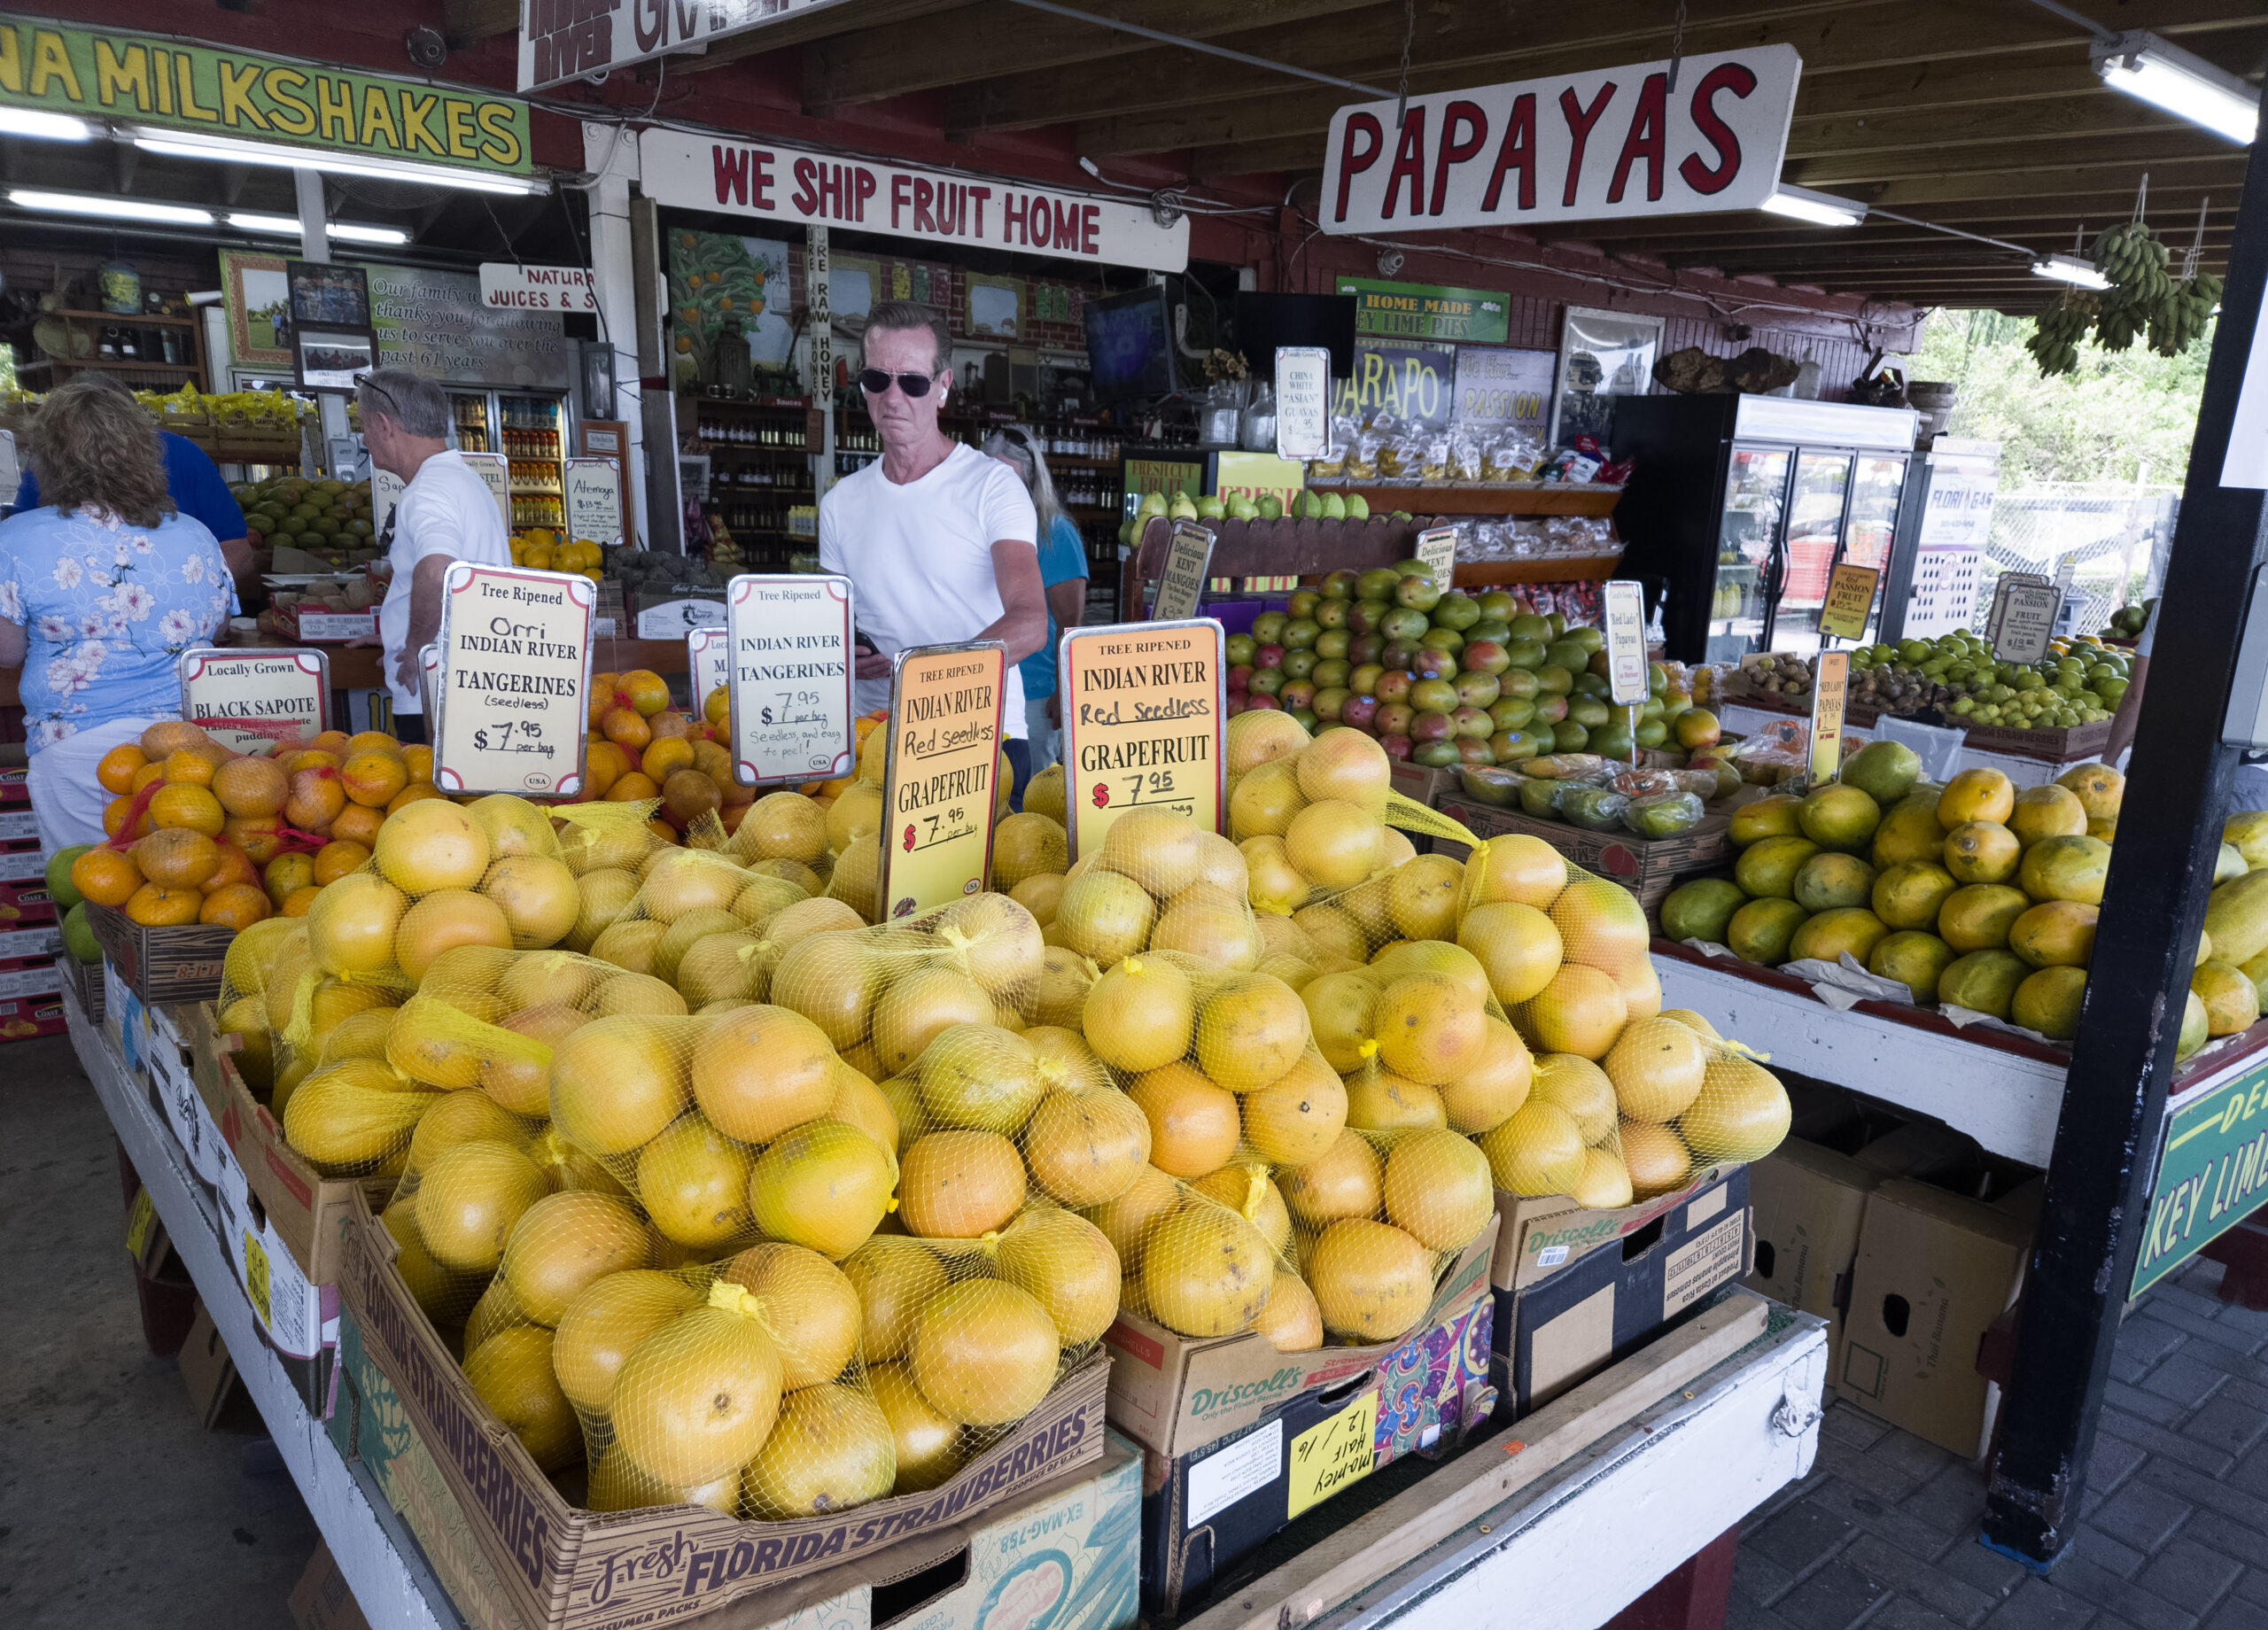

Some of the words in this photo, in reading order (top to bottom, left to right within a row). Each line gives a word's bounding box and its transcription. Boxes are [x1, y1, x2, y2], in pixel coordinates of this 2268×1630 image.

[533, 15, 613, 86] RIVER
[93, 40, 522, 166] MILKSHAKES
[1335, 62, 1758, 222] PAPAYAS
[712, 144, 775, 211] WE
[791, 157, 876, 222] SHIP
[890, 174, 991, 238] FRUIT
[1004, 192, 1100, 255] HOME
[373, 278, 404, 297] Our
[407, 282, 462, 305] family
[490, 290, 549, 307] JUICES
[561, 295, 571, 307] &
[818, 283, 830, 323] RAW
[1367, 294, 1418, 311] HOME
[1425, 299, 1472, 315] MADE
[376, 302, 431, 324] thanks
[436, 311, 462, 329] you
[464, 310, 491, 330] for
[496, 314, 560, 336] allowing
[1383, 311, 1425, 334] LIME
[1431, 315, 1469, 337] PIES
[377, 327, 396, 339] us
[401, 328, 417, 341] to
[423, 331, 462, 345] serve
[468, 334, 494, 352] you
[499, 338, 531, 352] over
[534, 335, 558, 353] the
[379, 349, 415, 365] past
[421, 350, 439, 365] 61
[444, 354, 488, 370] years.
[819, 337, 831, 402] HONEY
[1462, 354, 1480, 378] We
[1290, 371, 1313, 380] CHINA
[1285, 408, 1318, 417] GUAVAS
[1464, 388, 1541, 420] PASSION
[1132, 462, 1168, 477] FRESH
[1170, 464, 1193, 478] CUT
[573, 479, 615, 501] Atemoya
[1930, 490, 1964, 509] FLORI
[1970, 492, 1993, 509] GAS
[1175, 541, 1204, 560] Delicious
[1422, 544, 1452, 556] Delicious
[1177, 557, 1196, 572] KENT
[1166, 570, 1200, 591] MANGOES
[1835, 581, 1869, 594] PASSION
[481, 583, 509, 598] Tree
[513, 586, 563, 606] Ripened
[758, 590, 780, 601] Tree
[782, 589, 821, 602] Ripened
[1837, 591, 1863, 602] FRUIT
[2014, 598, 2048, 609] PASSION
[2016, 611, 2041, 620] FRUIT
[490, 617, 546, 640] Orri
[461, 634, 523, 655] INDIAN
[527, 641, 578, 660] RIVER
[741, 637, 793, 651] INDIAN
[796, 635, 841, 649] RIVER
[1099, 643, 1131, 656] TREE
[1136, 639, 1192, 654] RIPENED
[1615, 633, 1636, 648] Papayas
[208, 663, 251, 677] Locally
[254, 663, 294, 673] Grown
[738, 662, 845, 681] TANGERINES
[920, 668, 944, 683] TREE
[946, 663, 984, 679] RIPENED
[1083, 666, 1147, 692] INDIAN
[1152, 661, 1208, 686] RIVER
[456, 670, 576, 696] TANGERINES
[196, 701, 251, 718] BLACK
[255, 697, 315, 715] SAPOTE
[485, 695, 549, 710] (seedless)
[906, 692, 953, 725] INDIAN
[955, 685, 992, 713] RIVER
[1081, 701, 1119, 726] Red
[1135, 696, 1210, 722] Seedless
[1819, 698, 1842, 712] PAPAYAS
[802, 729, 819, 740] and
[820, 729, 842, 744] easy
[905, 731, 936, 757] Red
[1996, 729, 2060, 745] STRAWBERRIES
[517, 742, 534, 754] per
[538, 741, 555, 759] bag
[763, 746, 777, 757] to
[1081, 734, 1209, 772] GRAPEFRUIT
[898, 763, 990, 812] GRAPEFRUIT
[947, 826, 961, 844] per
[967, 881, 978, 891] USA
[2142, 1159, 2213, 1271] KEY
[2208, 1128, 2268, 1224] LIME
[1528, 1218, 1621, 1254] Driscoll's
[1727, 1237, 1740, 1251] FRUIT
[1712, 1246, 1727, 1261] COUNT
[1713, 1246, 1739, 1270] pineapple
[1692, 1265, 1713, 1285] ananas
[1719, 1260, 1739, 1280] Product
[1796, 1244, 1809, 1287] Banana
[1696, 1278, 1711, 1292] Costa
[1712, 1274, 1718, 1285] of
[1682, 1289, 1695, 1303] Rica
[1792, 1287, 1802, 1311] Thai
[1932, 1298, 1949, 1339] Banana
[1926, 1339, 1940, 1369] Thai
[1192, 1366, 1306, 1417] Driscoll's
[1201, 1410, 1219, 1421] Only
[1220, 1407, 1231, 1417] the
[1233, 1400, 1255, 1412] Finest
[1257, 1392, 1283, 1406] Berries
[1243, 1424, 1256, 1435] AT
[410, 1336, 548, 1589] STRAWBERRIES
[1005, 1468, 1045, 1495] PRODUCE
[1047, 1462, 1059, 1471] OF
[1060, 1447, 1084, 1466] U.S.A.
[591, 1530, 699, 1605] Fresh
[682, 1524, 851, 1598] FLORIDA
[849, 1404, 1087, 1549] STRAWBERRIES
[1000, 1501, 1084, 1554] EX-MAG-758
[657, 1599, 701, 1618] PACKS
